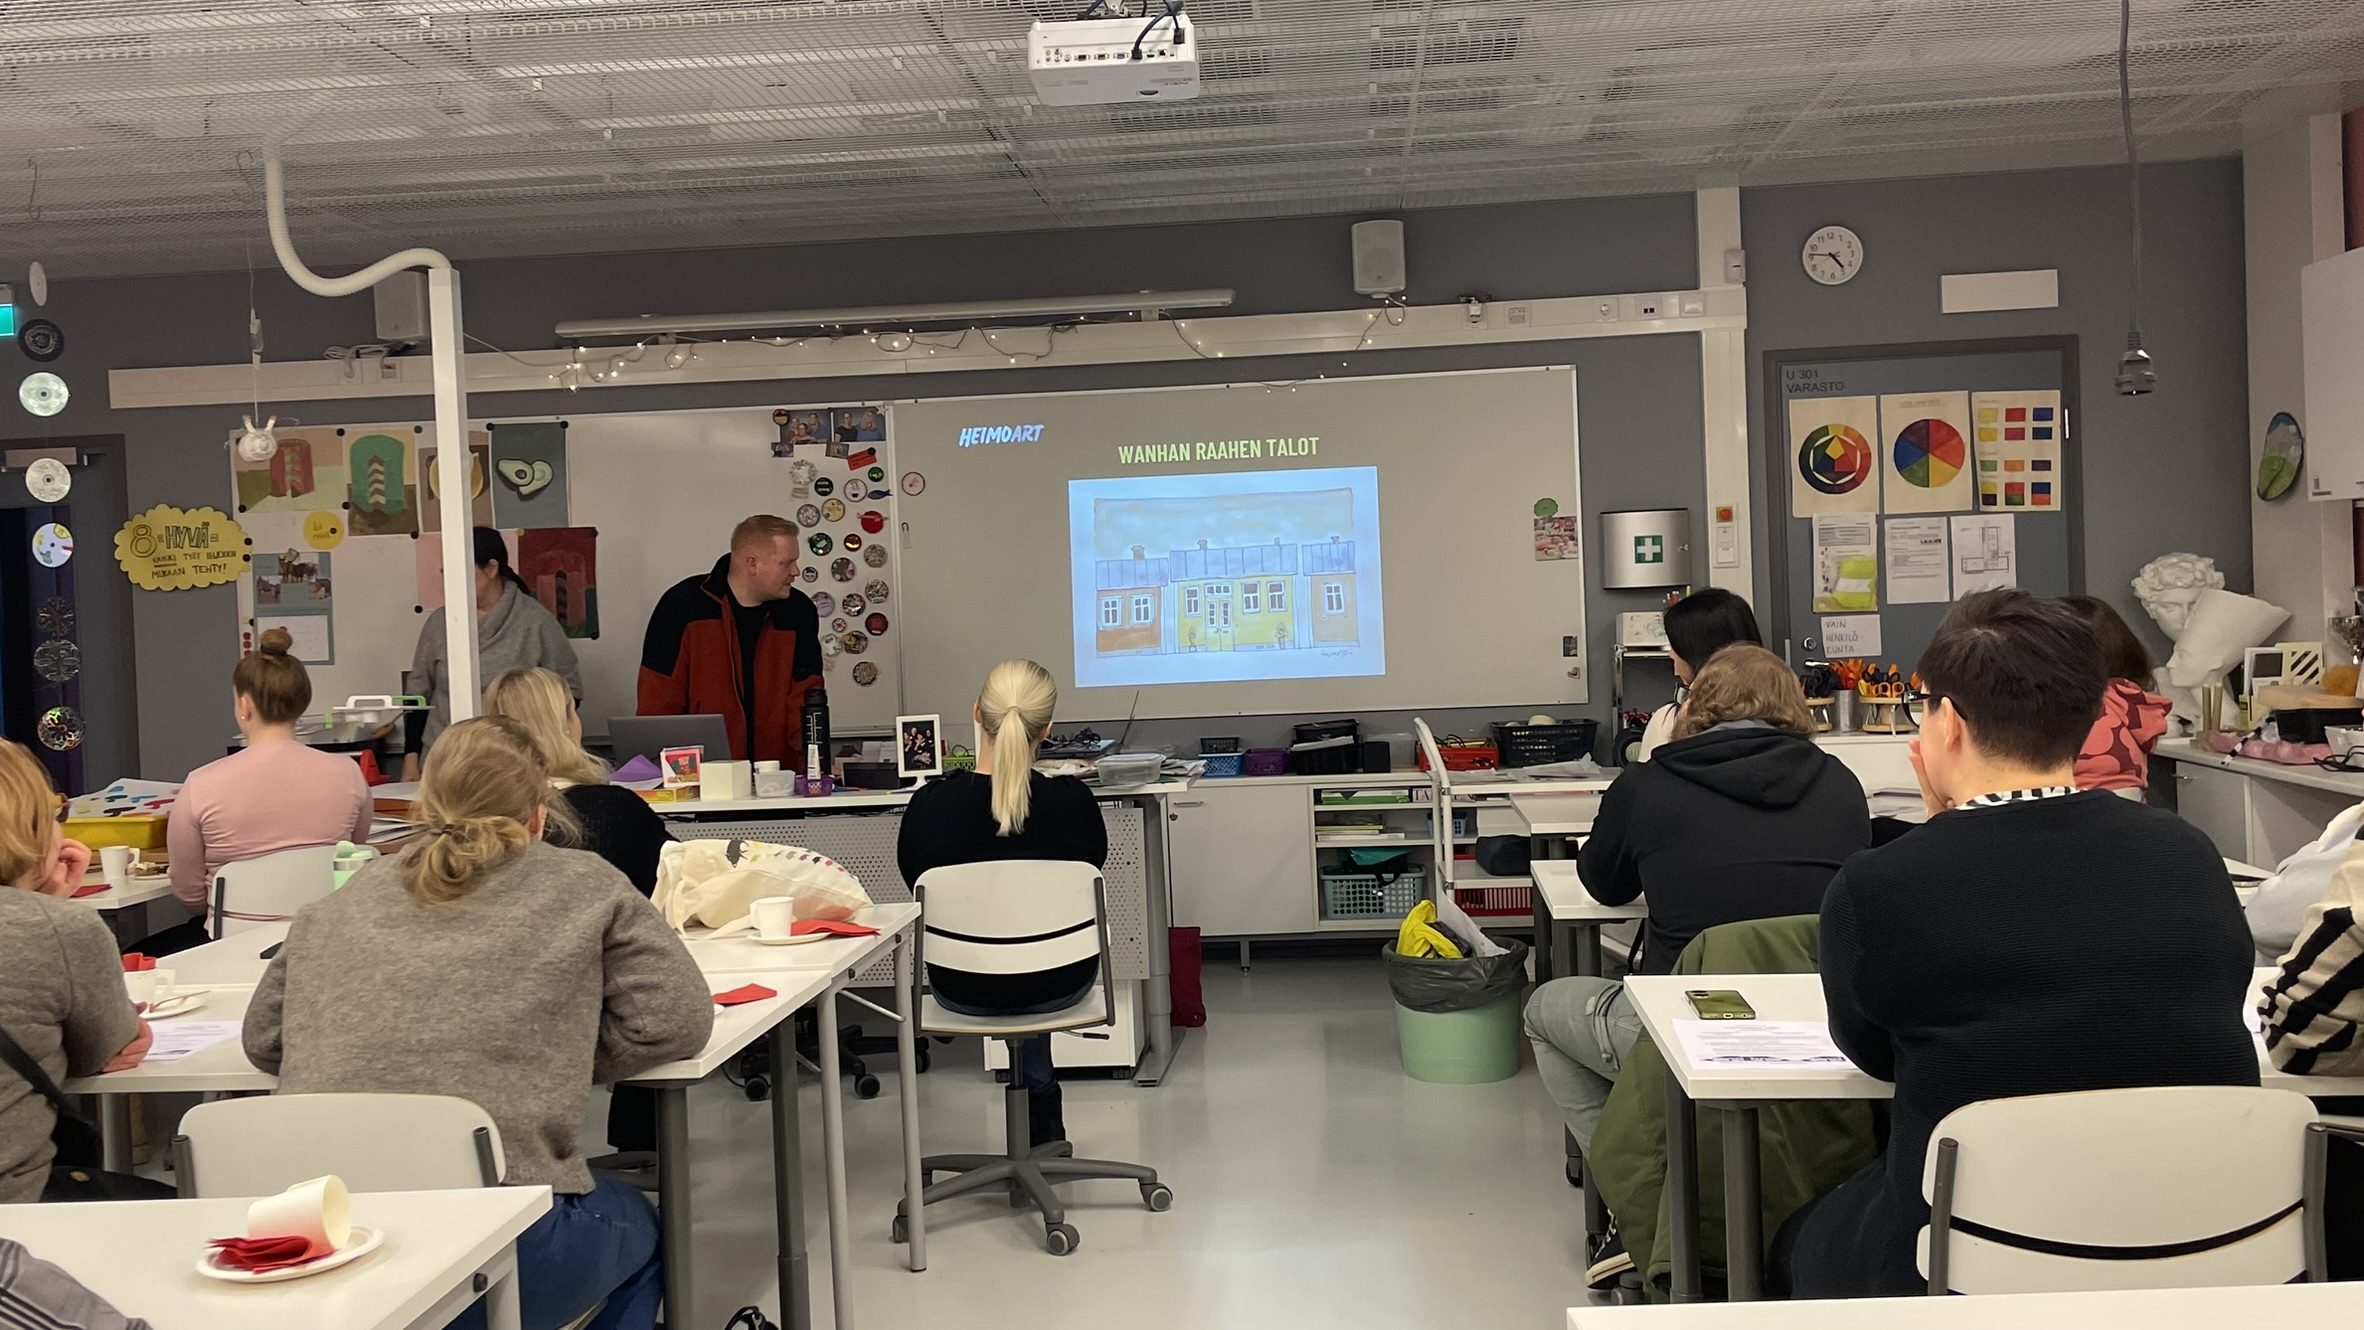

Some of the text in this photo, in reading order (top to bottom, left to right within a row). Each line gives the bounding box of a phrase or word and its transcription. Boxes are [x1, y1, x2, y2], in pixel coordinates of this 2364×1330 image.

[1817, 236, 1825, 244] 11
[1826, 232, 1834, 240] 12
[1810, 244, 1818, 252] 10
[1786, 369, 1819, 380] U 301
[1786, 381, 1845, 394] VARASTO
[958, 424, 1045, 448] HEIMOART
[1118, 436, 1320, 464] WANHAN RAAHEN TALOT
[130, 524, 158, 559] 8
[165, 521, 210, 549] HYVÄ
[151, 563, 227, 580] MUKAAN TEHTY!
[1825, 620, 1847, 629] VAIN
[1826, 644, 1855, 655] KUNTA
